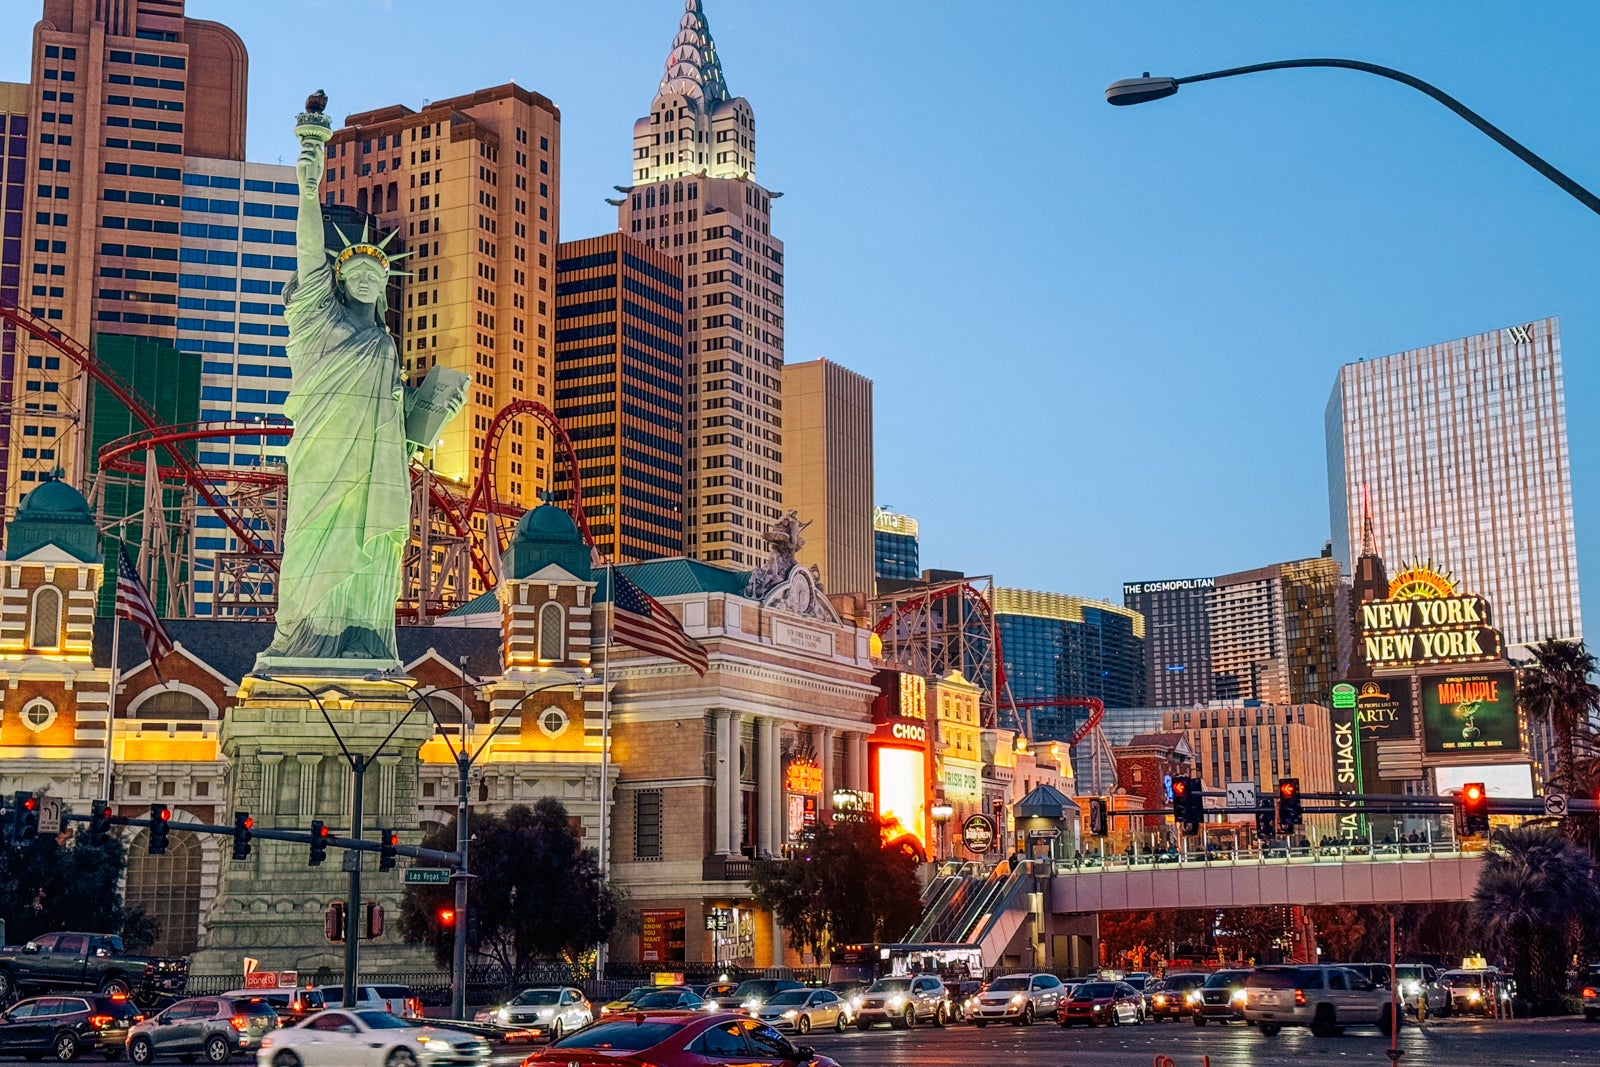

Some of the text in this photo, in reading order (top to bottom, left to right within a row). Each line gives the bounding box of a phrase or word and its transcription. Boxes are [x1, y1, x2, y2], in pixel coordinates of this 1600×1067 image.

[1123, 578, 1215, 594] THE COSMOPOLITAN
[1363, 598, 1480, 629] NEW YORK
[1365, 630, 1483, 661] NEW YORK
[1438, 680, 1499, 704] MAD APPLE
[1357, 708, 1398, 722] ARTY.
[1334, 722, 1355, 783] SHACK
[964, 775, 976, 789] PUB
[410, 872, 420, 880] Las
[423, 872, 440, 882] Vegas
